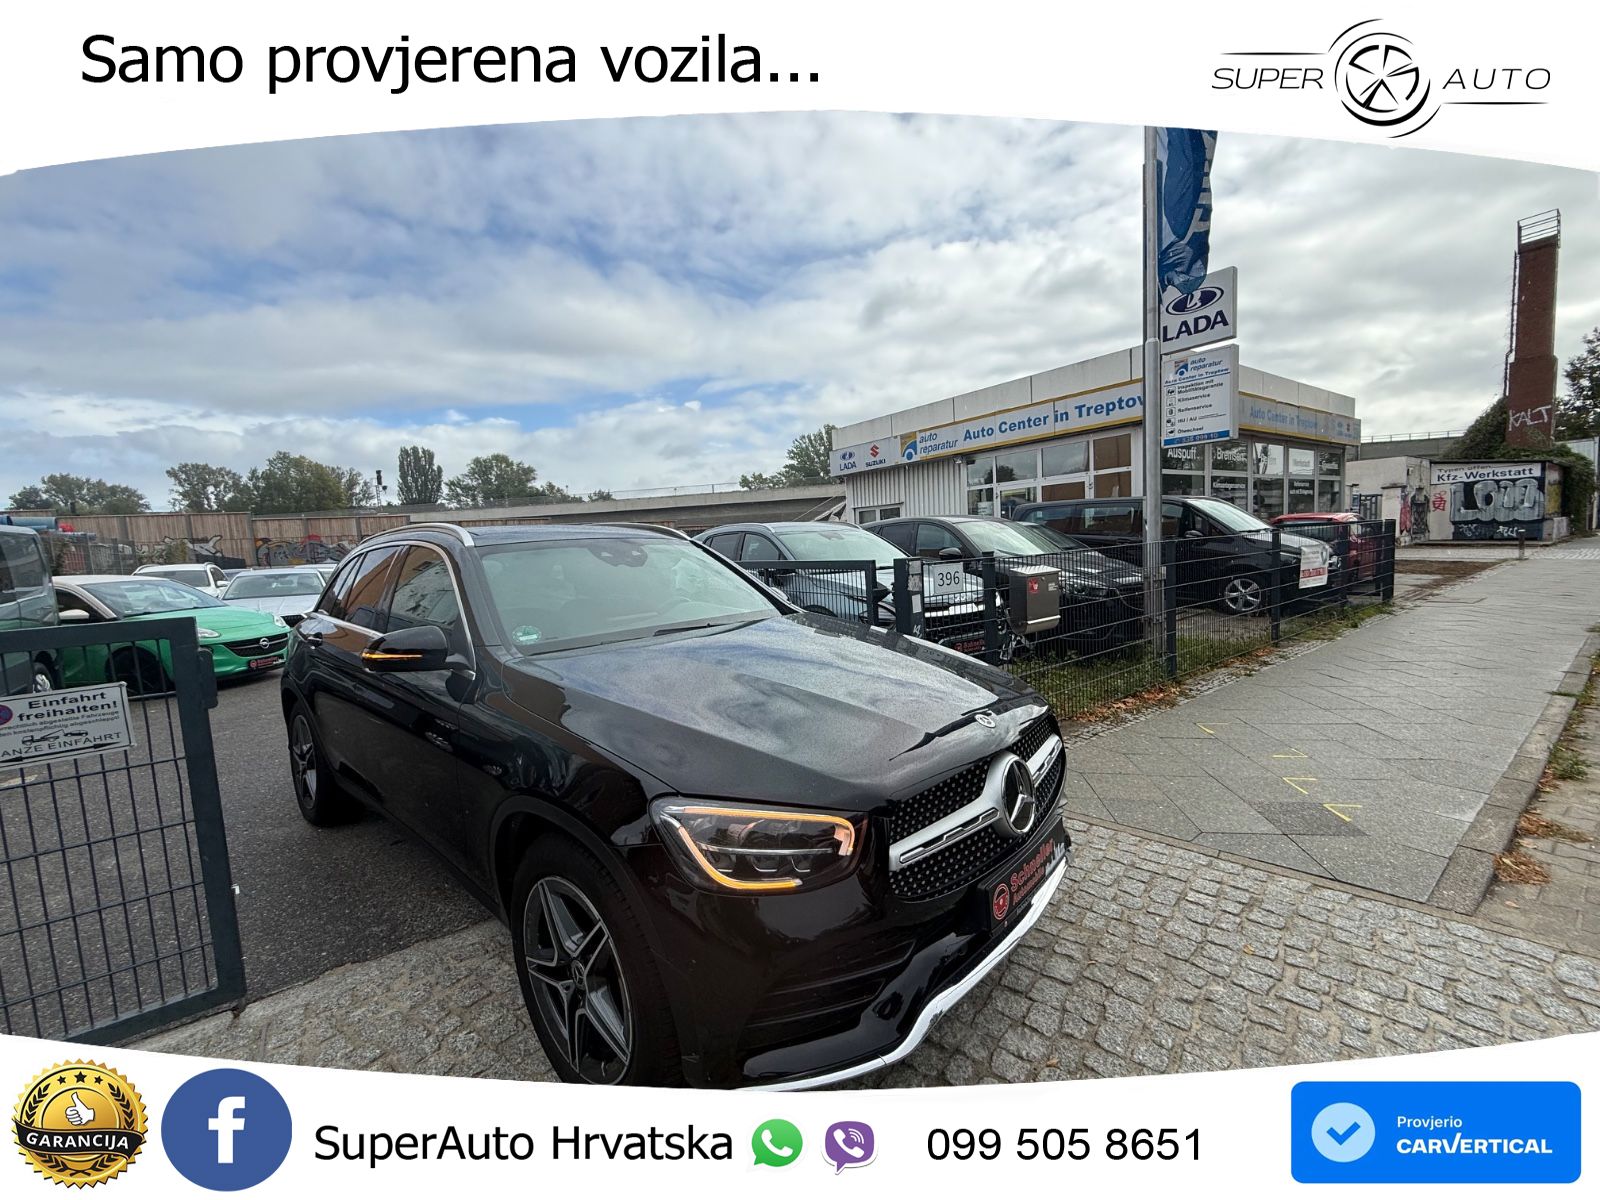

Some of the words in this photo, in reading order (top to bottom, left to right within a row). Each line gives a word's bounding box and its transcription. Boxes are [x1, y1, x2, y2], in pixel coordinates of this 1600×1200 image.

[1163, 310, 1229, 342] LADA
[1250, 406, 1265, 420] Auto
[963, 427, 994, 441] Auto
[999, 415, 1049, 433] Center
[1055, 410, 1069, 423] in
[919, 432, 937, 444] auto
[920, 438, 958, 455] reparatur
[1167, 447, 1197, 462] Auspuff
[839, 461, 857, 471] LADA
[866, 458, 886, 468] SUZUKI
[1437, 467, 1534, 482] Kfz-Werkstatt
[937, 571, 960, 587] 396
[28, 692, 107, 709] Einfahrt
[18, 700, 118, 721] freihalten!
[0, 746, 42, 758] ANZE
[48, 732, 122, 750] EINFAHRT
